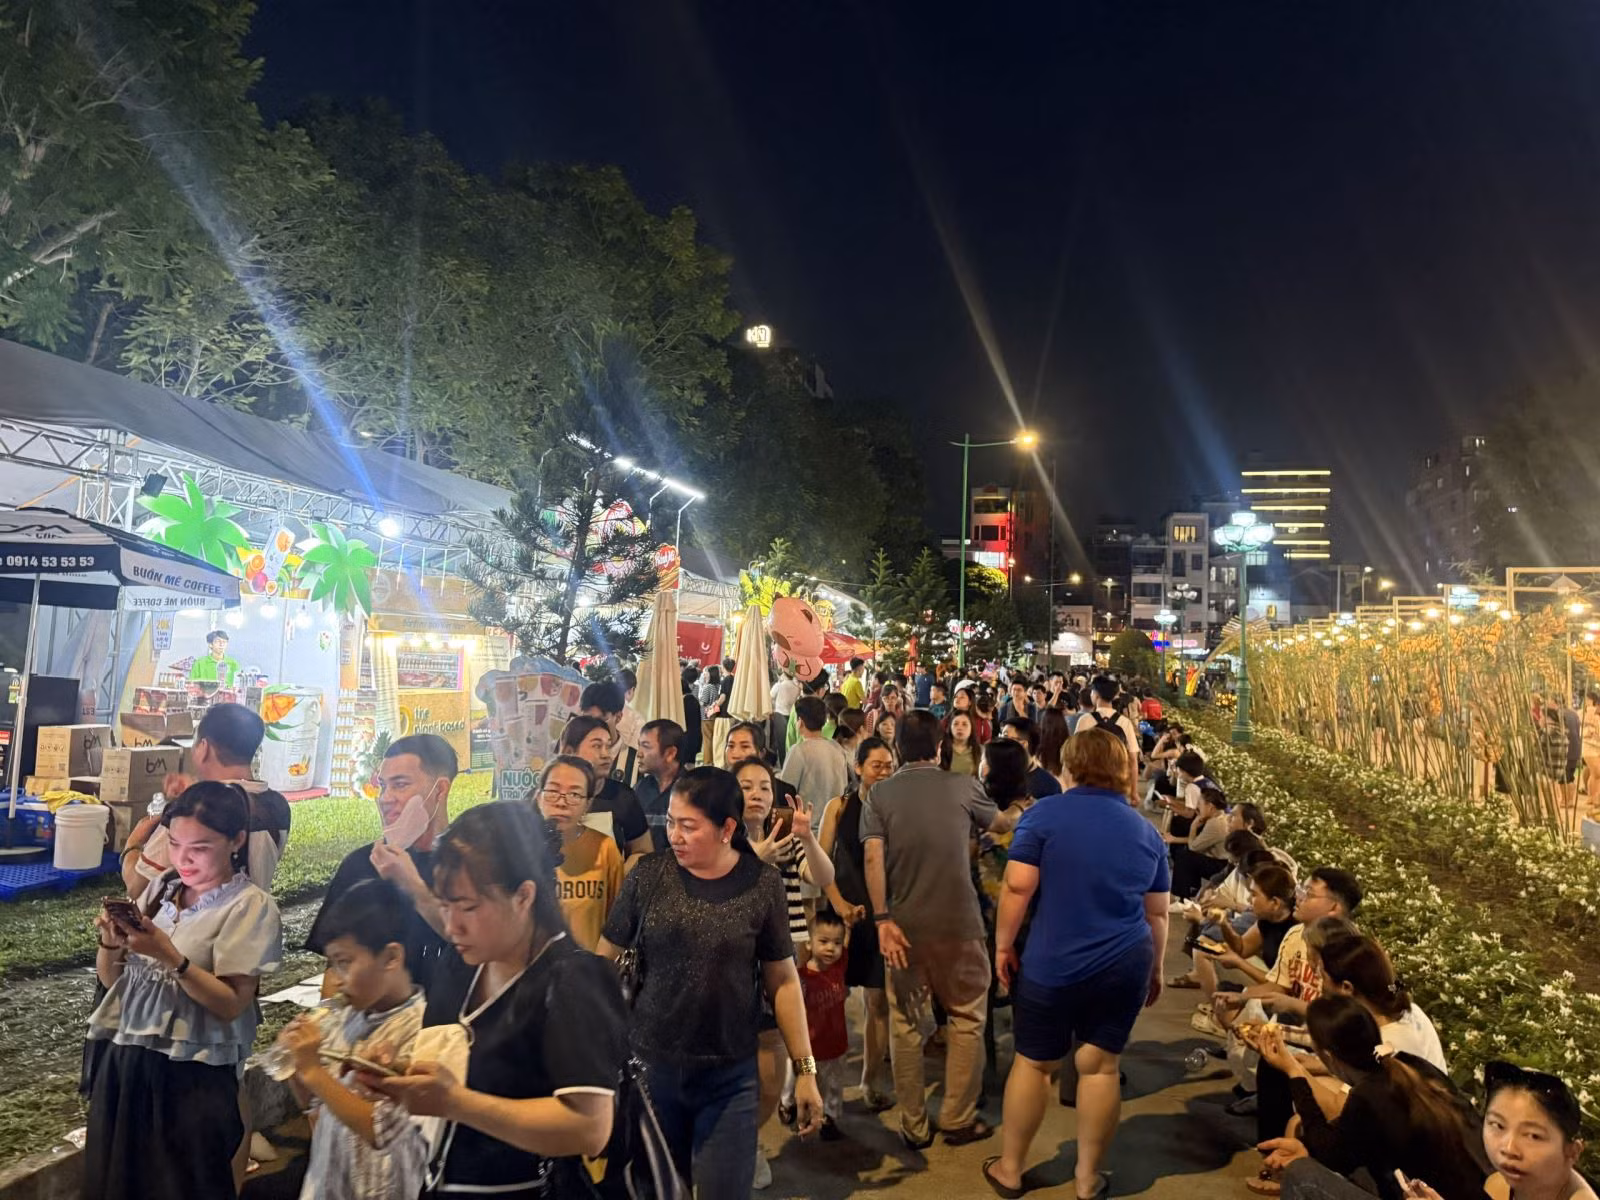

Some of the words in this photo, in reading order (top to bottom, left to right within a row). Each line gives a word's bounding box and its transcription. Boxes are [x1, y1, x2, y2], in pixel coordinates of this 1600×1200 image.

[6, 555, 38, 567] 0914
[41, 556, 57, 567] 53
[60, 556, 76, 567] 53
[79, 556, 95, 567] 53
[183, 579, 222, 594] COFFEE
